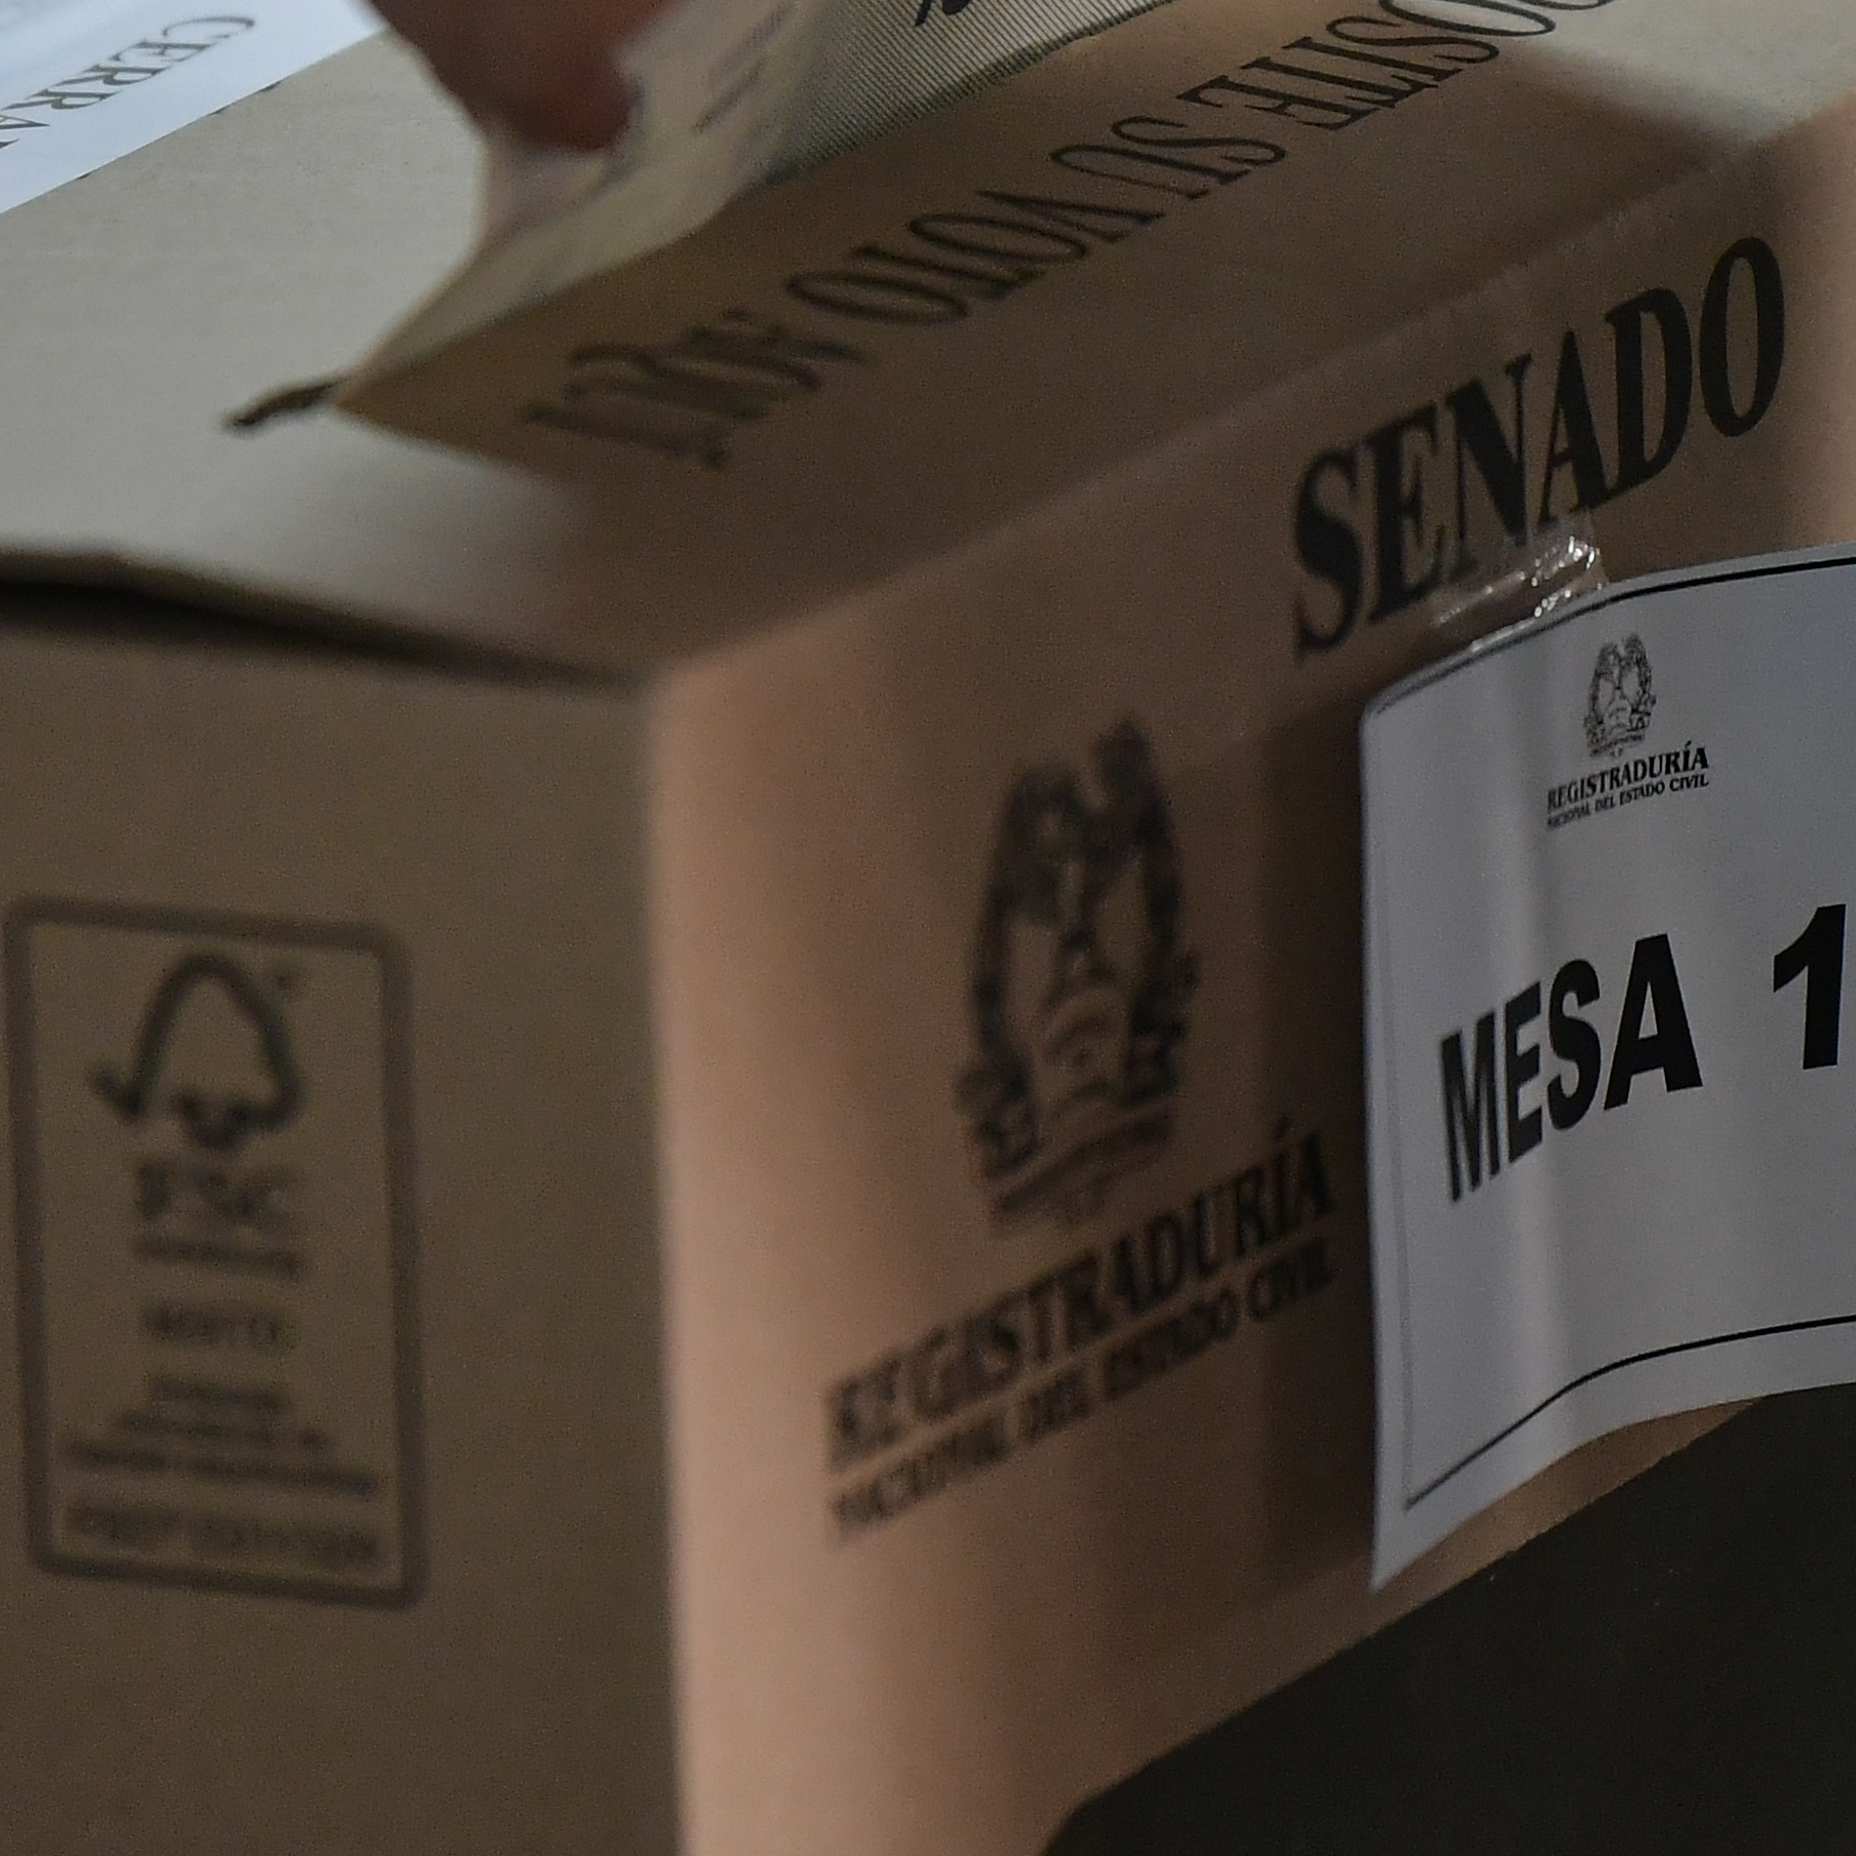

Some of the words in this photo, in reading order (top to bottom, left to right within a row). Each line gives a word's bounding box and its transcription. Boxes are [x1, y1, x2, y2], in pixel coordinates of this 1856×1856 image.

[1049, 115, 1287, 201] SU
[785, 188, 1167, 326] VOTO
[1293, 236, 1786, 667] SENADO
[1547, 739, 1709, 811] REGISTRADURÍA
[1595, 795, 1617, 813] DEL
[1619, 781, 1666, 806] ESTADO
[1669, 774, 1710, 792] CIVIL
[1439, 932, 1704, 1203] MESA
[828, 1114, 1335, 1474] REGISTRADURÍA
